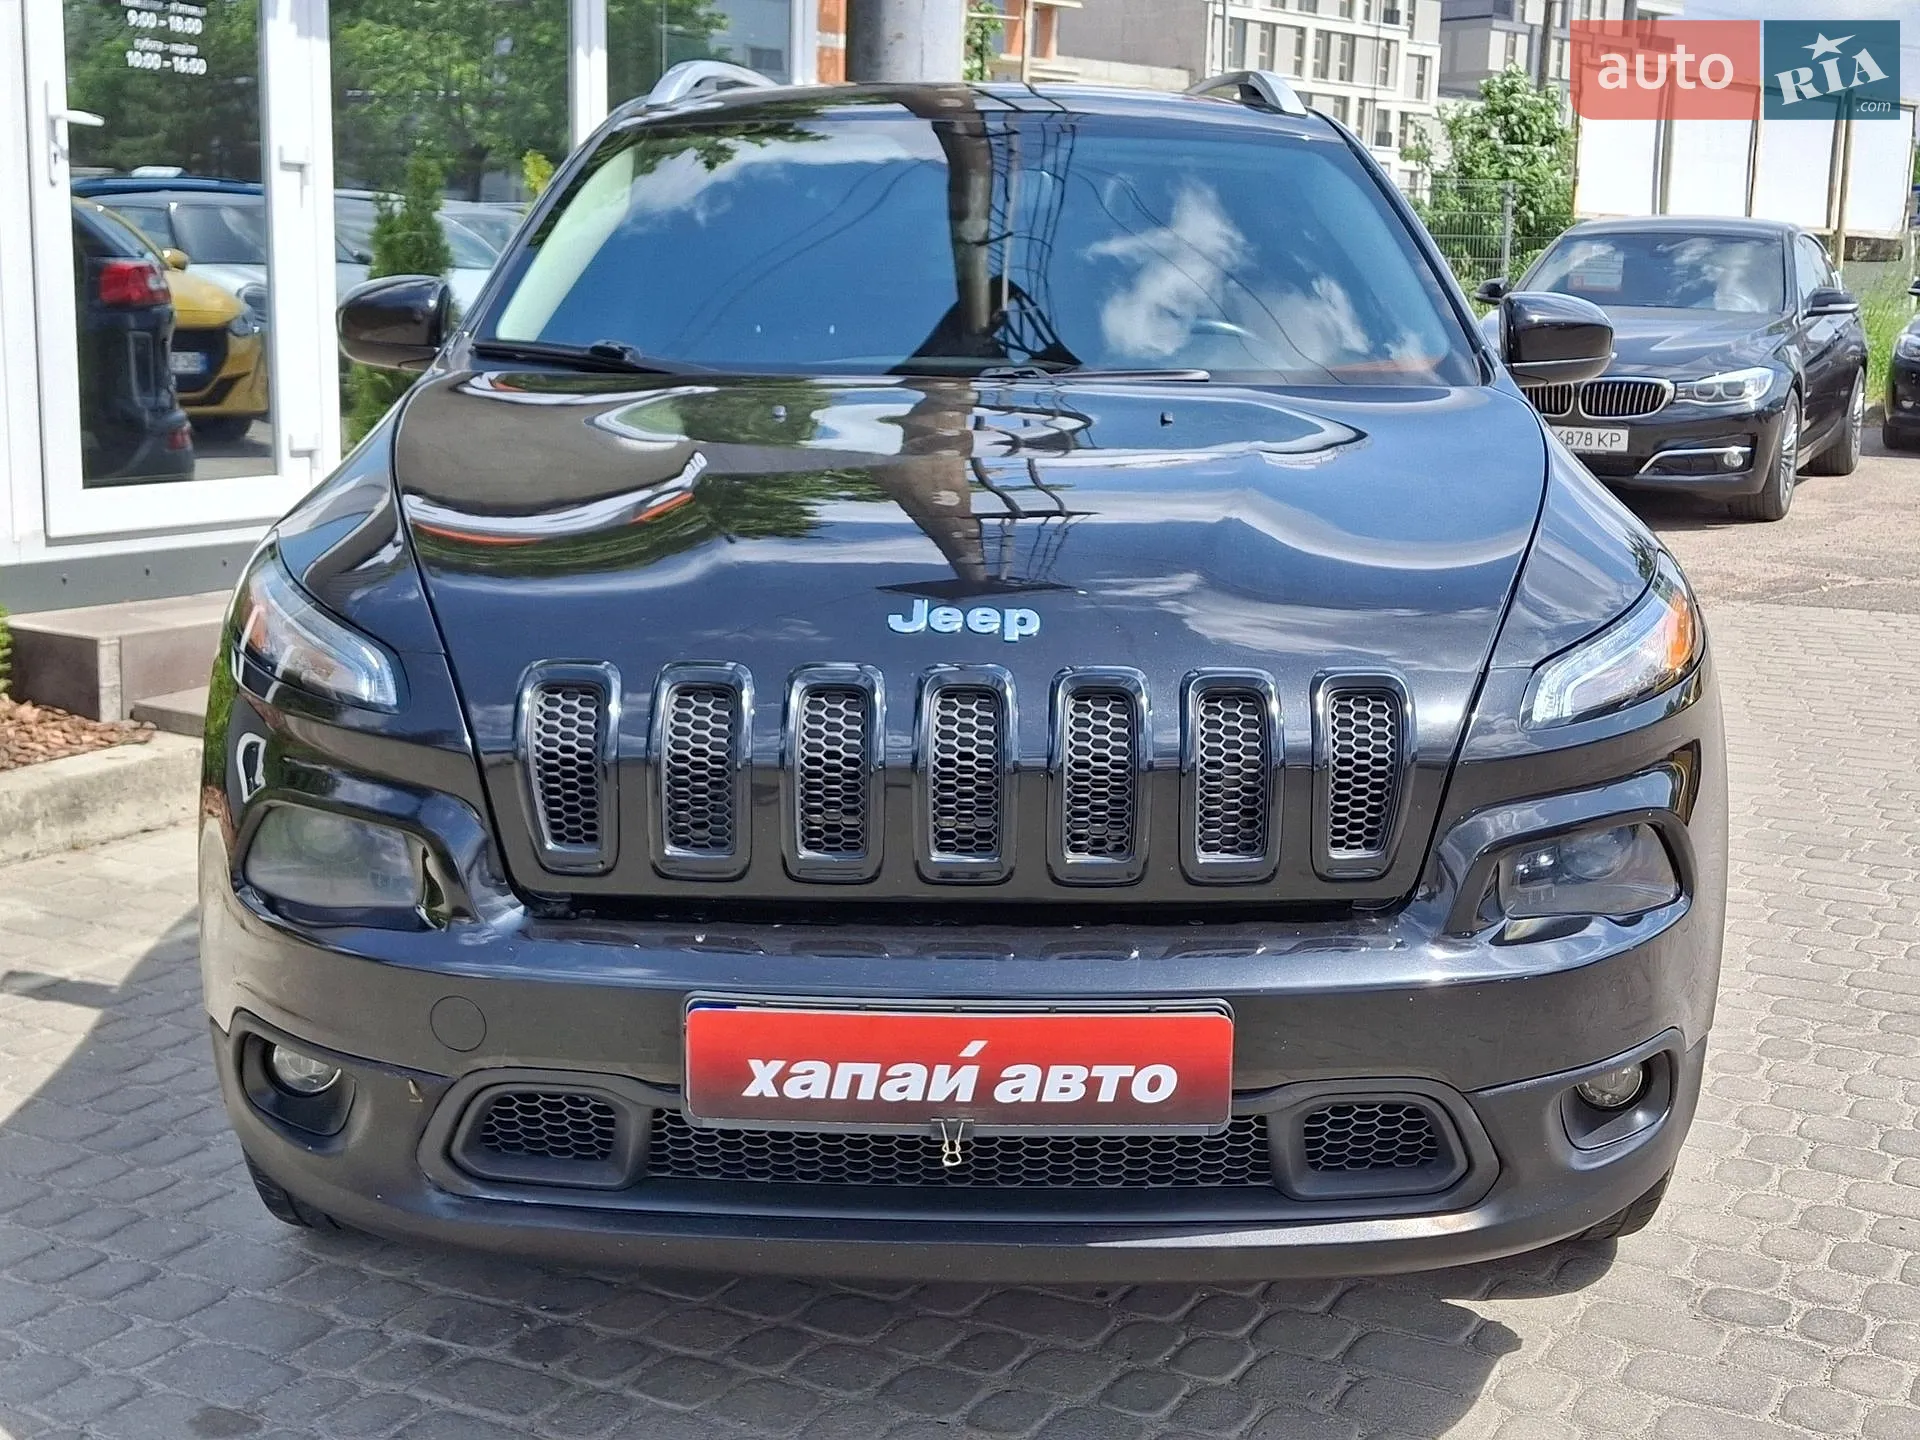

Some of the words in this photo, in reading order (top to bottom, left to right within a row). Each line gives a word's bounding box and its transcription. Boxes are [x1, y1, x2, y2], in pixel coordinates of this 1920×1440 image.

[126, 50, 162, 70] 10:00
[1598, 432, 1622, 448] KP
[887, 599, 1041, 642] Jeep
[993, 1063, 1178, 1104] авто
